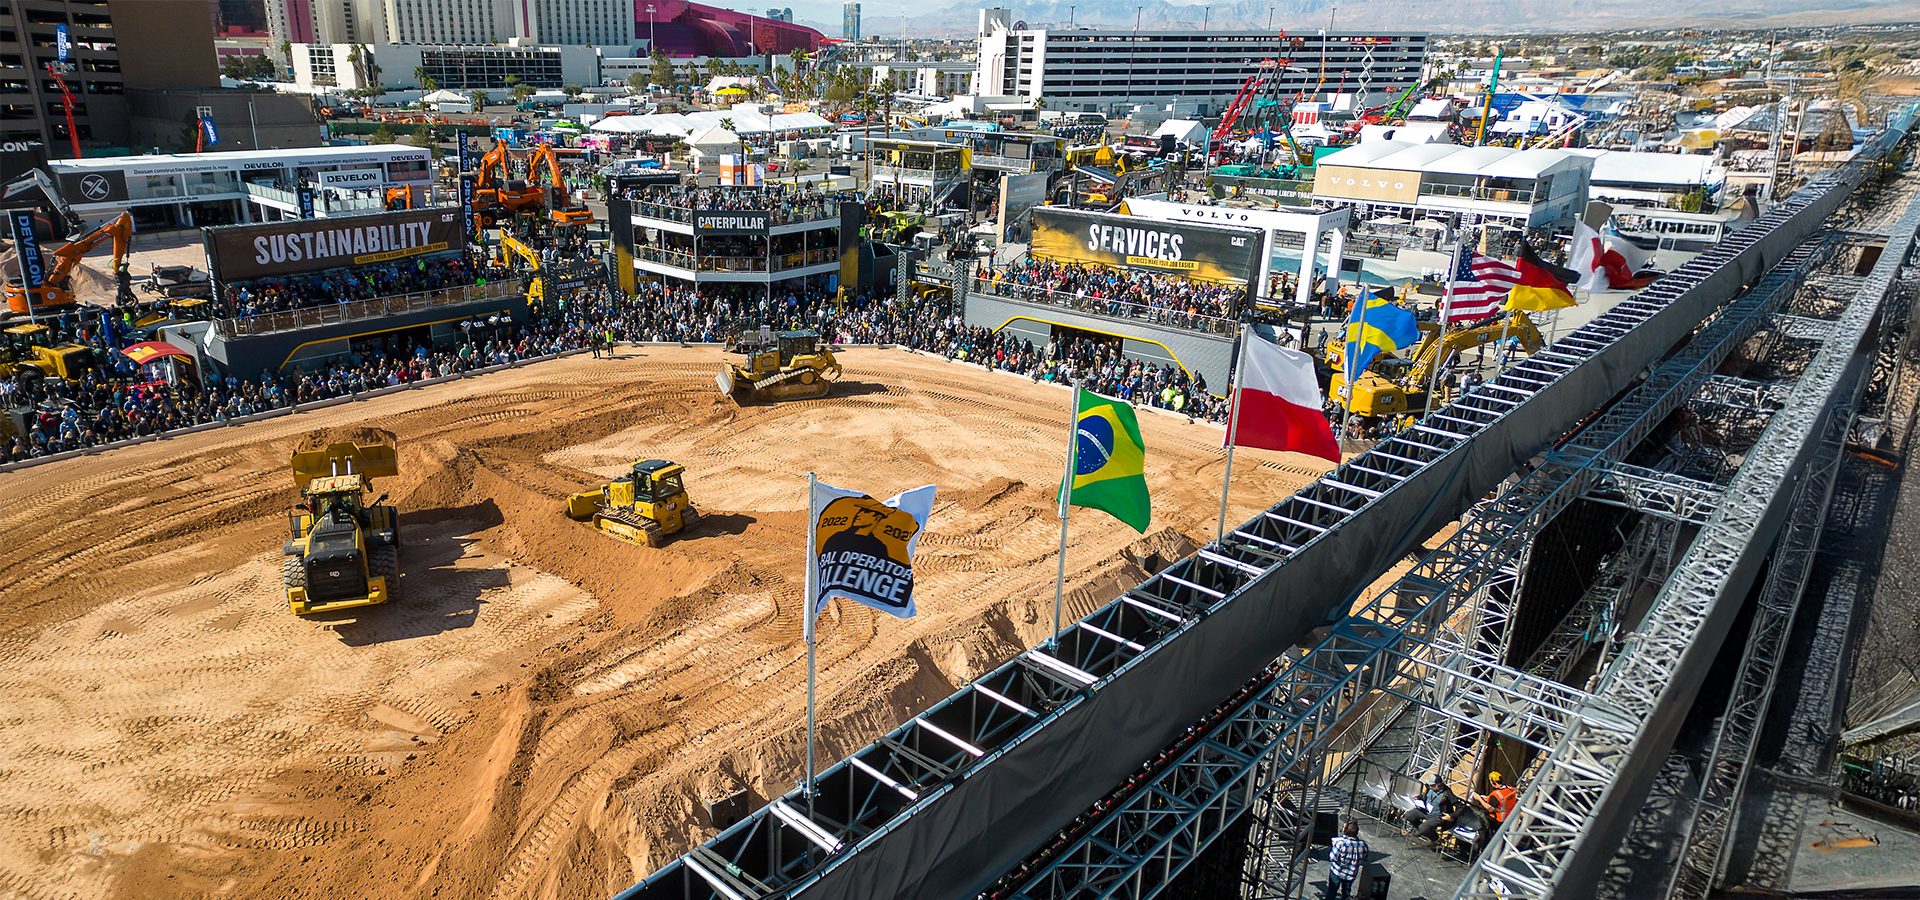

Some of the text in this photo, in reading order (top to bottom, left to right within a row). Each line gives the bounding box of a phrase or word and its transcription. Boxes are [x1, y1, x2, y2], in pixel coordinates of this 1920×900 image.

[244, 161, 284, 169] DEVELON
[326, 172, 377, 183] DEVELON
[1330, 176, 1404, 190] VOLVO
[463, 179, 473, 235] DEVELON
[441, 213, 454, 223] CAT
[1182, 208, 1249, 221] VOLVO
[698, 216, 764, 230] CATERPILLAR
[253, 221, 432, 265] SUSTAINABILITY
[1088, 223, 1184, 261] SERVICES
[1230, 236, 1246, 247] CAT
[17, 215, 43, 287] DEVELON
[357, 255, 374, 263] CHOOSE
[1130, 257, 1195, 269] CHOICES MAKE YOUR JOB EASIER
[1476, 332, 1488, 341] CAT
[1328, 351, 1340, 363] CAT
[1381, 395, 1393, 404] CAT
[822, 516, 848, 528] 2022
[839, 551, 912, 580] OPERATOR
